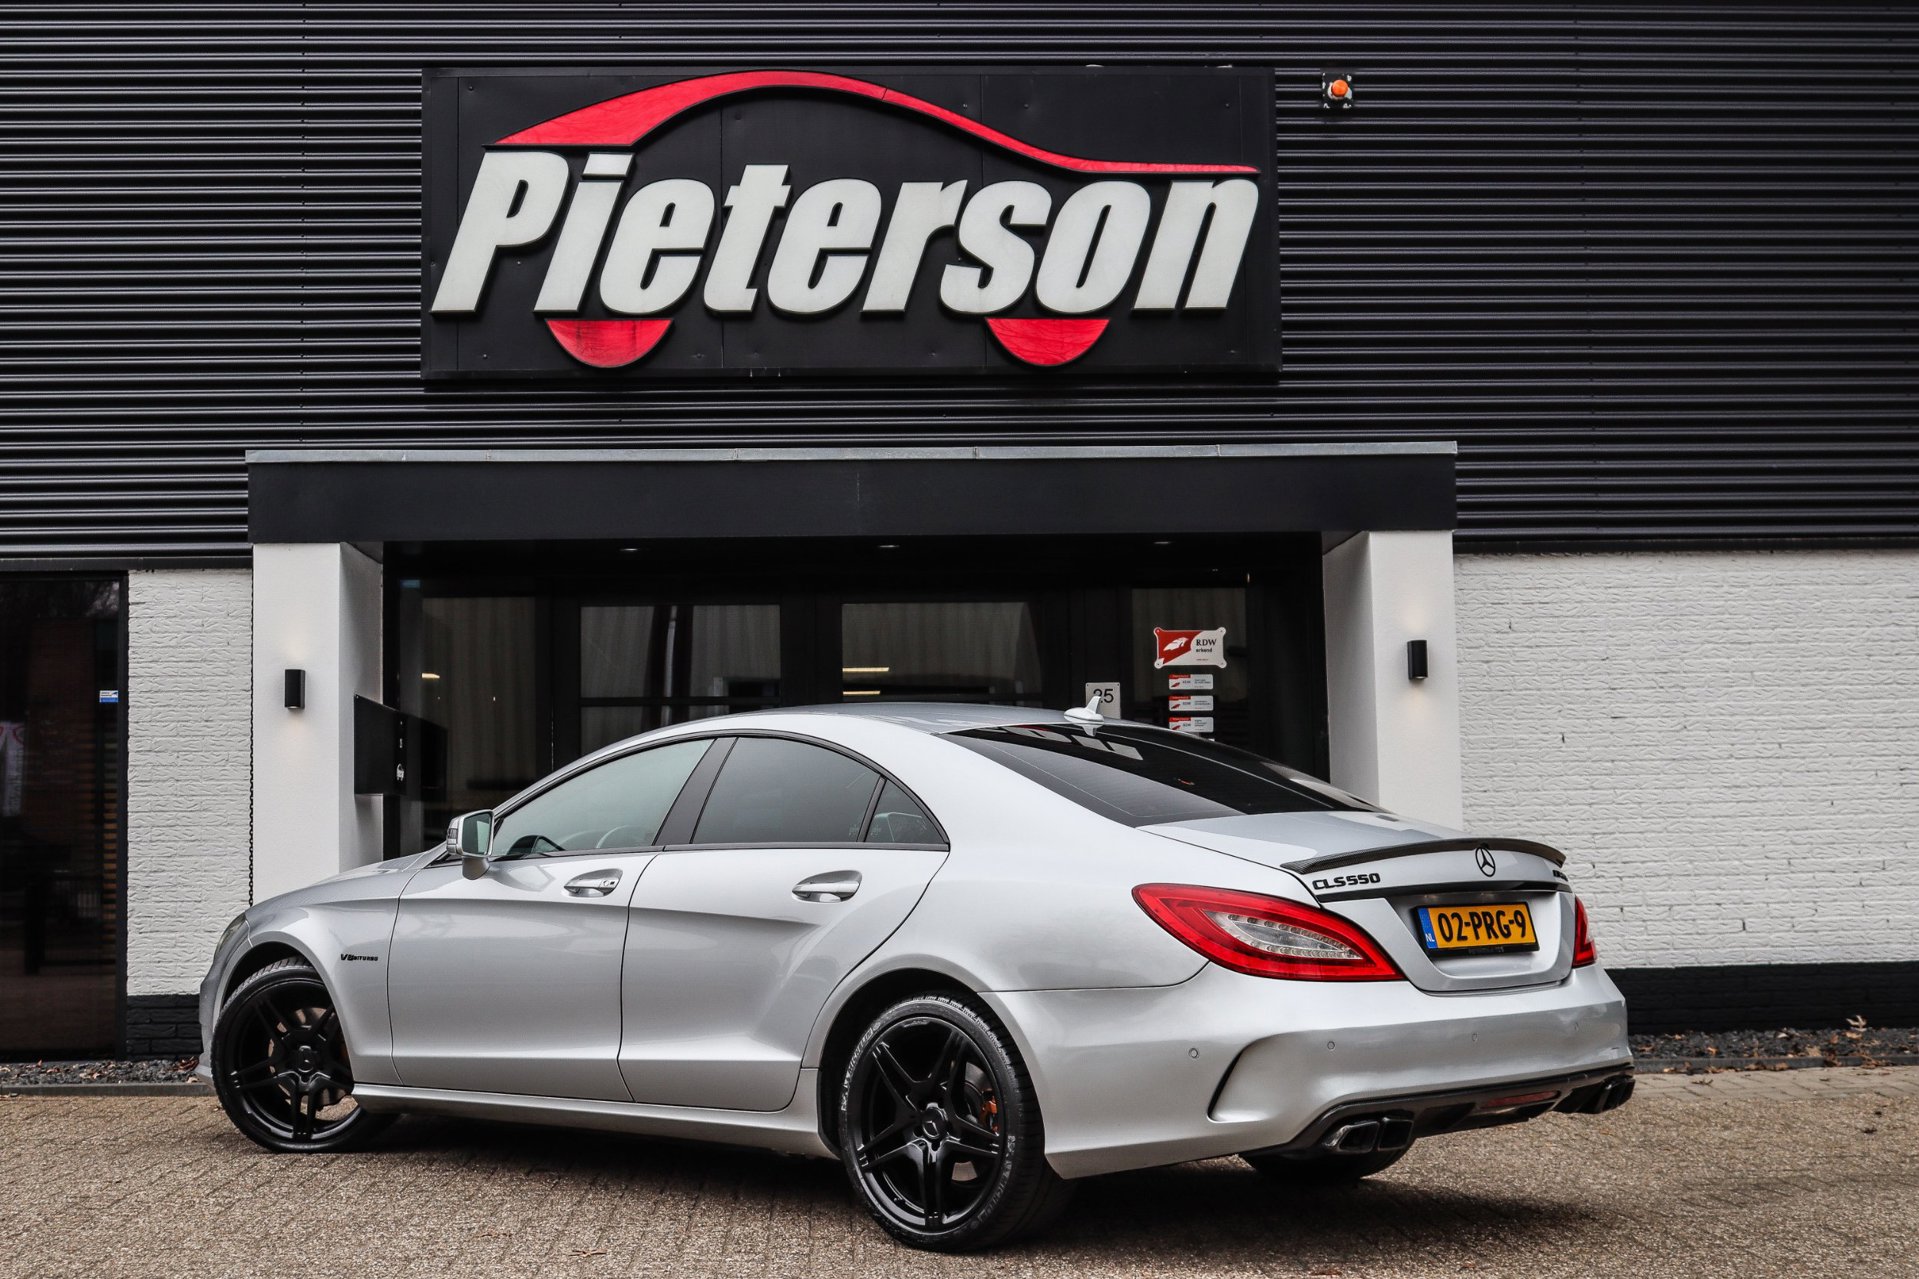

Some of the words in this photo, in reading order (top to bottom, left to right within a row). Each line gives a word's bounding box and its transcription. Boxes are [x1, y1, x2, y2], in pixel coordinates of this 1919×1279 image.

[430, 150, 1261, 316] Pieterson
[1196, 638, 1217, 646] RDW
[1312, 872, 1381, 890] CLS550
[1437, 909, 1527, 943] 02-PRG-9
[1425, 932, 1436, 943] NL
